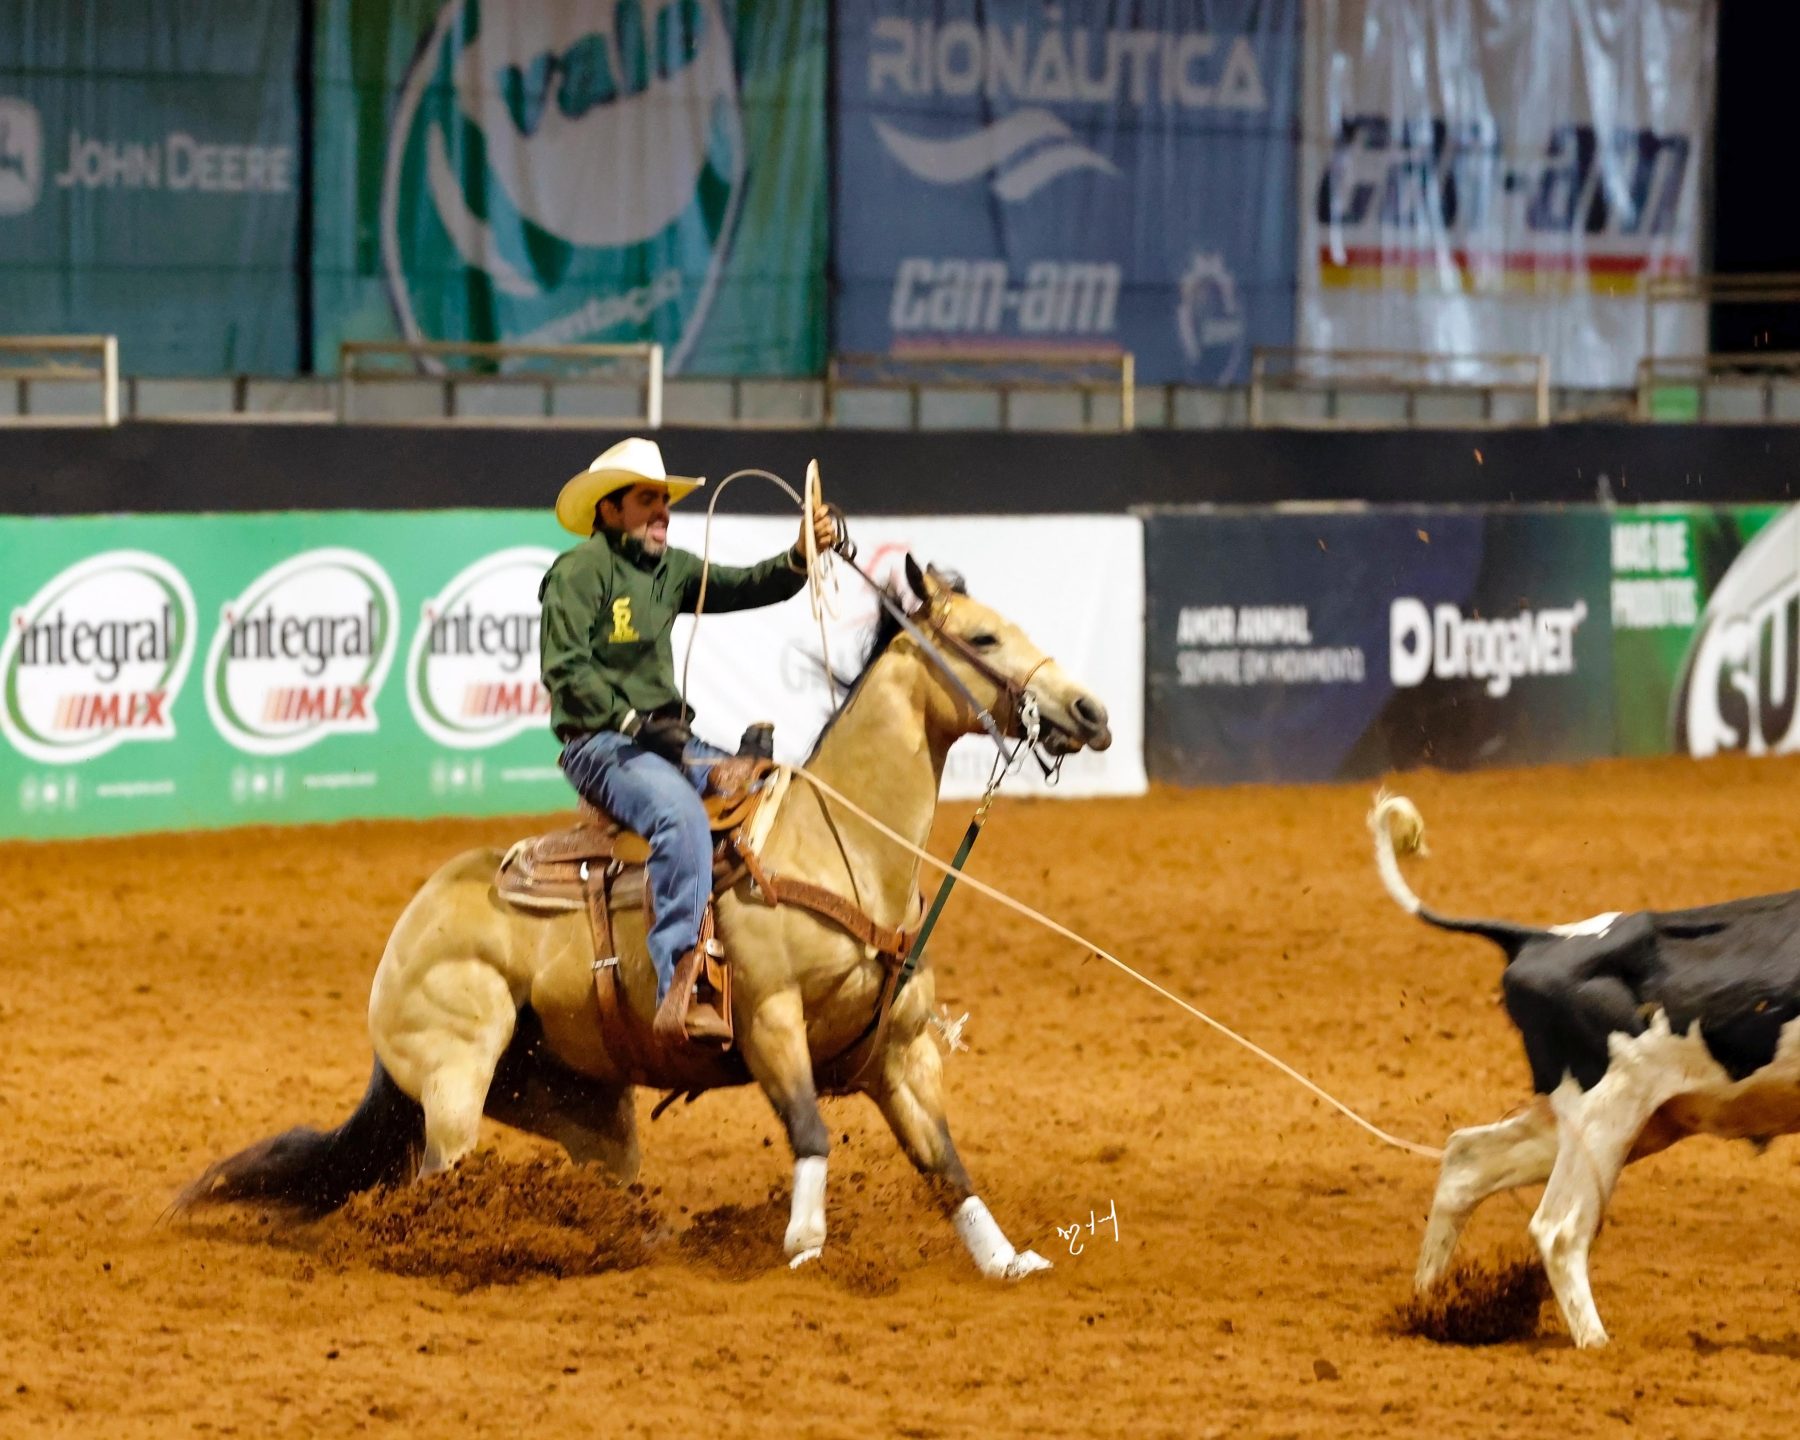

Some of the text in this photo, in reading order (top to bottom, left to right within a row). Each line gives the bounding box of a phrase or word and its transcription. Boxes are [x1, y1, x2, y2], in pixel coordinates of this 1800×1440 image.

[55, 128, 288, 193] JOHN DEERE
[889, 258, 1122, 332] can-am
[17, 603, 170, 683] integral
[226, 601, 373, 676] integral
[495, 681, 551, 717] MI
